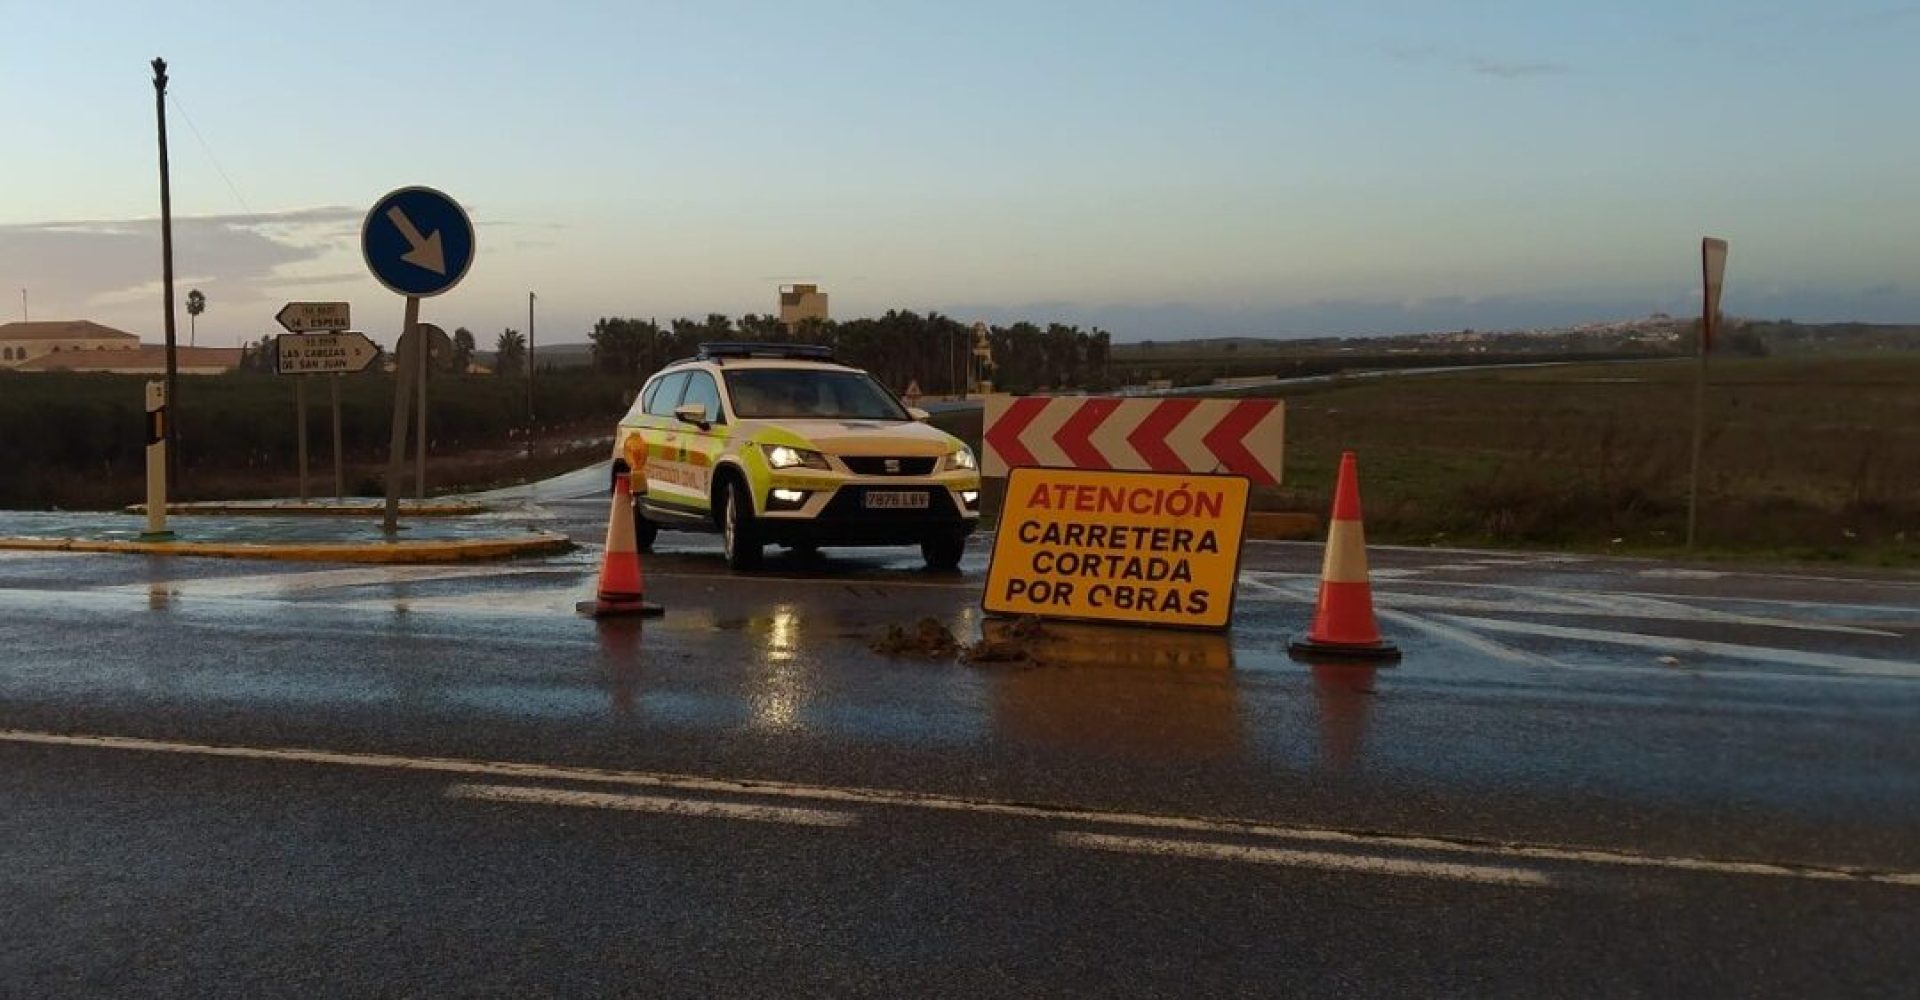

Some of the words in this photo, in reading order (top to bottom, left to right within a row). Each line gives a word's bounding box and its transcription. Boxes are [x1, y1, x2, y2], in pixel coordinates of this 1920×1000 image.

[311, 319, 346, 328] ESPERA
[282, 350, 299, 358] LAS
[304, 348, 346, 358] CABEZAS
[282, 361, 294, 370] DE
[300, 360, 319, 369] SAN
[325, 360, 347, 368] JUAN
[1027, 479, 1224, 518] ATENCIÓN
[1018, 520, 1219, 554] CARRETERA
[1032, 550, 1192, 583] CORTADA
[1005, 578, 1075, 606] POR
[1087, 583, 1210, 615] OBRAS
